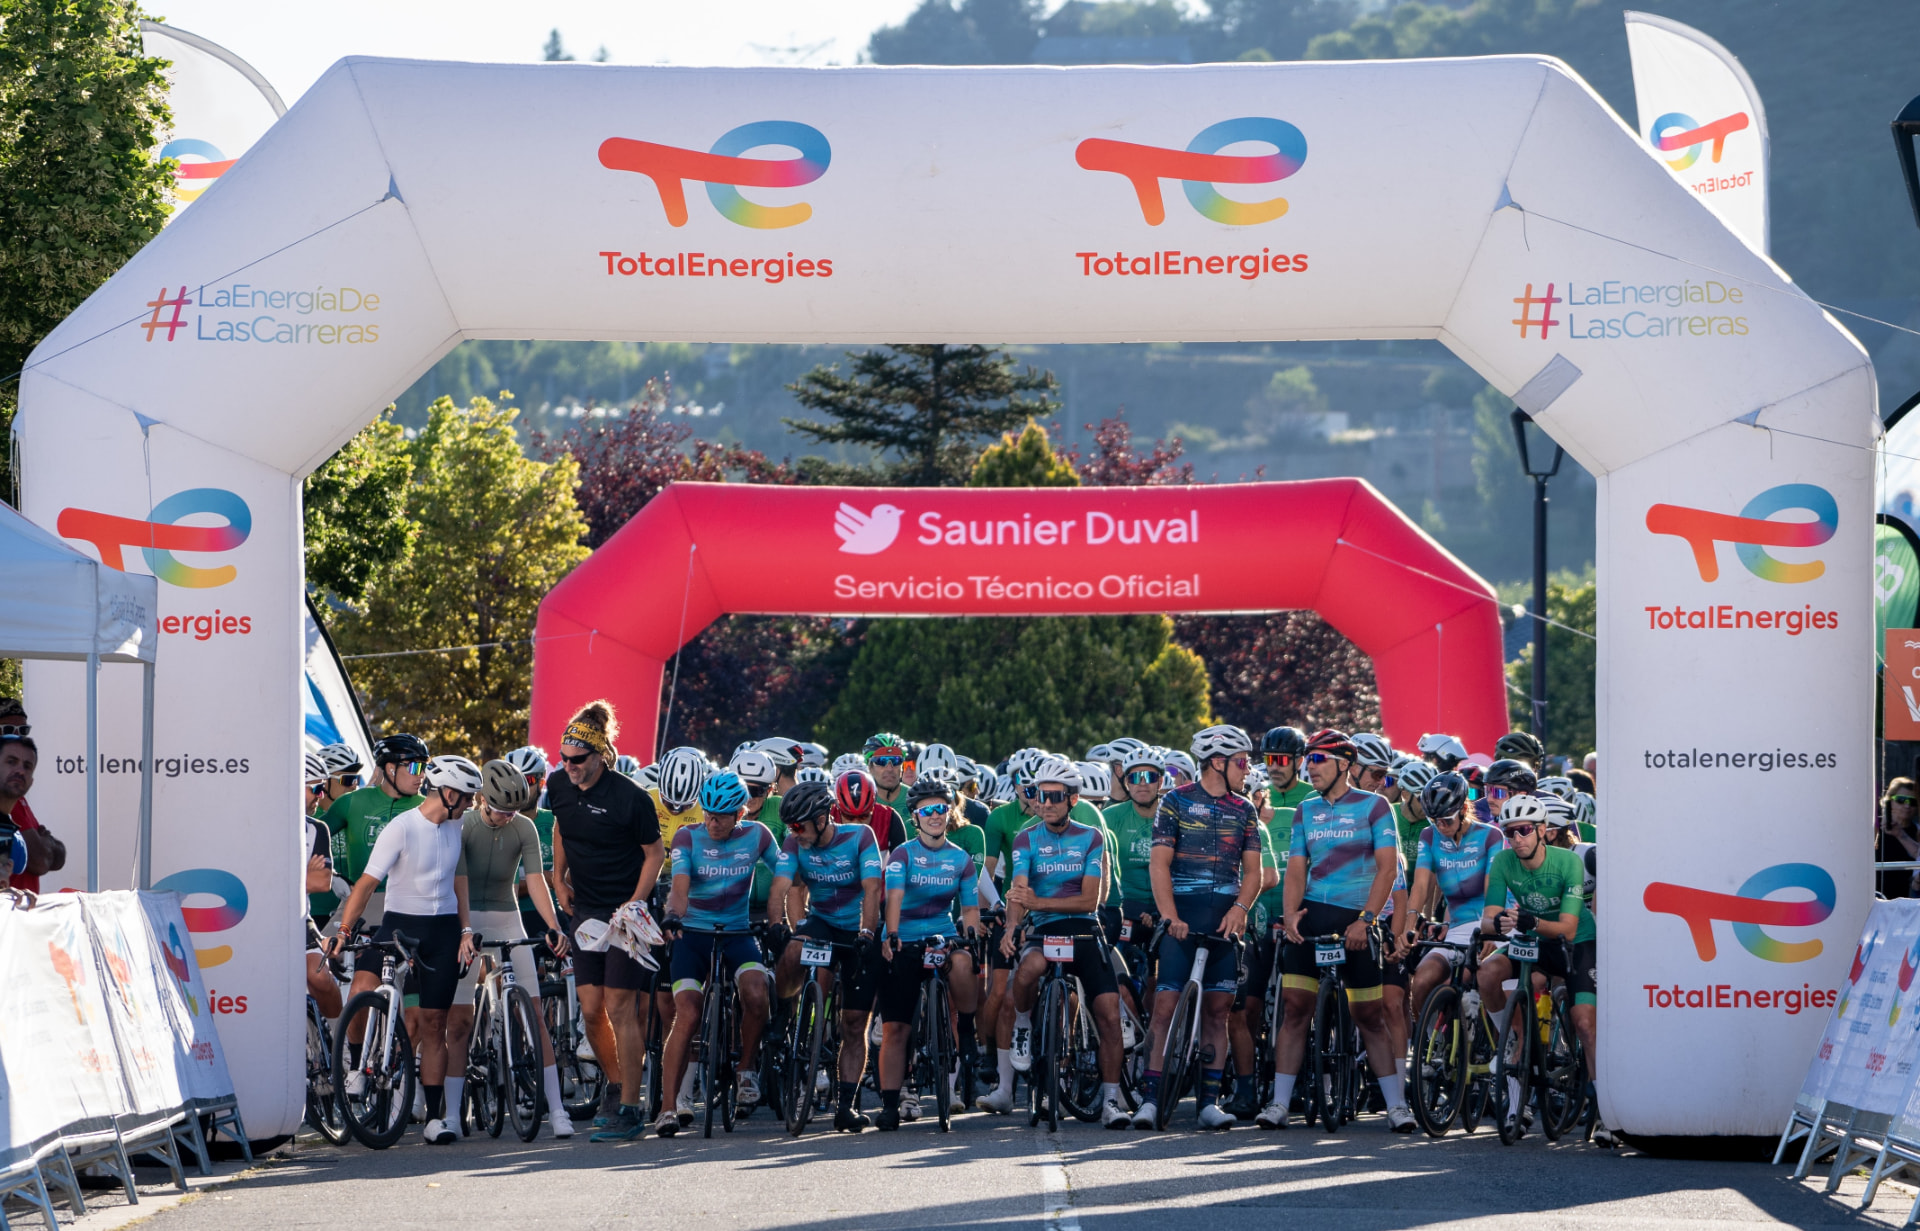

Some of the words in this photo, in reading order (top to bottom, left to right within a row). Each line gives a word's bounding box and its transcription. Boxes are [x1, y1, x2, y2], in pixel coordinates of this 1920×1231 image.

[599, 251, 833, 284] TotalEnergies
[1075, 247, 1309, 280] TotalEnergies
[197, 315, 379, 345] LasCarreras
[1569, 311, 1750, 340] LasCarreras
[917, 512, 1077, 546] Saunier
[1086, 510, 1199, 545] Duval
[834, 575, 964, 600] Servicio
[968, 575, 1094, 600] Técnico
[1098, 574, 1200, 598] Oficial
[1645, 604, 1839, 636] TotalEnergies
[56, 754, 250, 778] totlenrgies.es
[1645, 748, 1837, 772] totalenergies.es
[1307, 828, 1354, 841] alpinum
[697, 864, 750, 877] alpinum
[808, 871, 854, 882] alpinum
[910, 873, 954, 886] alpinum
[1037, 862, 1082, 874] alpinum
[805, 950, 827, 961] 741
[1319, 951, 1341, 961] 784
[1512, 947, 1534, 958] 806
[503, 973, 515, 983] 19
[1643, 983, 1838, 1015] TotalEnergies
